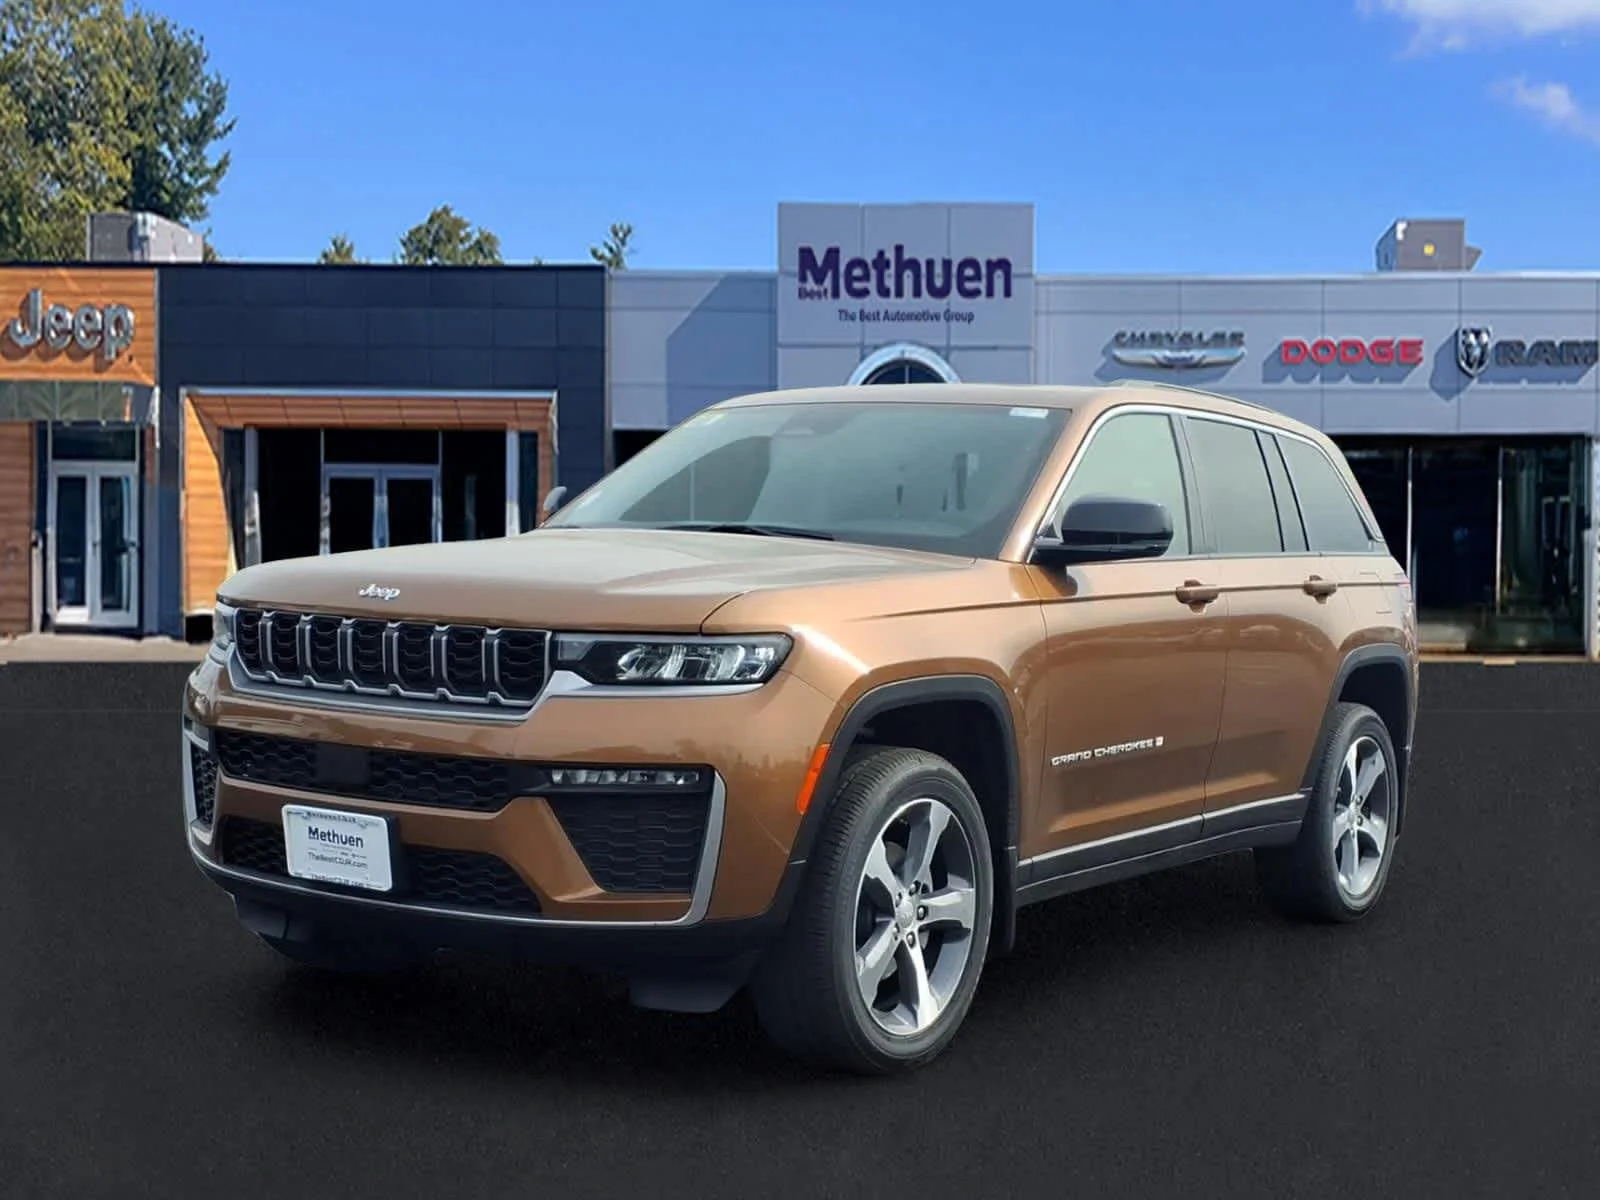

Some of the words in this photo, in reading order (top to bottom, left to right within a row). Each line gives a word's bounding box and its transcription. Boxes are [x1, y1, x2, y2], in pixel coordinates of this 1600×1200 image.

[798, 244, 1012, 299] Methuen
[9, 287, 134, 360] Jeep
[838, 309, 857, 322] The
[859, 309, 881, 322] Best
[882, 309, 941, 322] Automotive
[943, 309, 975, 325] Group
[1114, 331, 1245, 346] CHRYSLER
[1281, 339, 1424, 364] DODGE
[1495, 340, 1599, 366] RAM
[359, 583, 401, 601] Jeep
[1051, 750, 1092, 766] GRAND
[1094, 738, 1154, 757] CHEROKEE
[308, 826, 364, 849] Methuen
